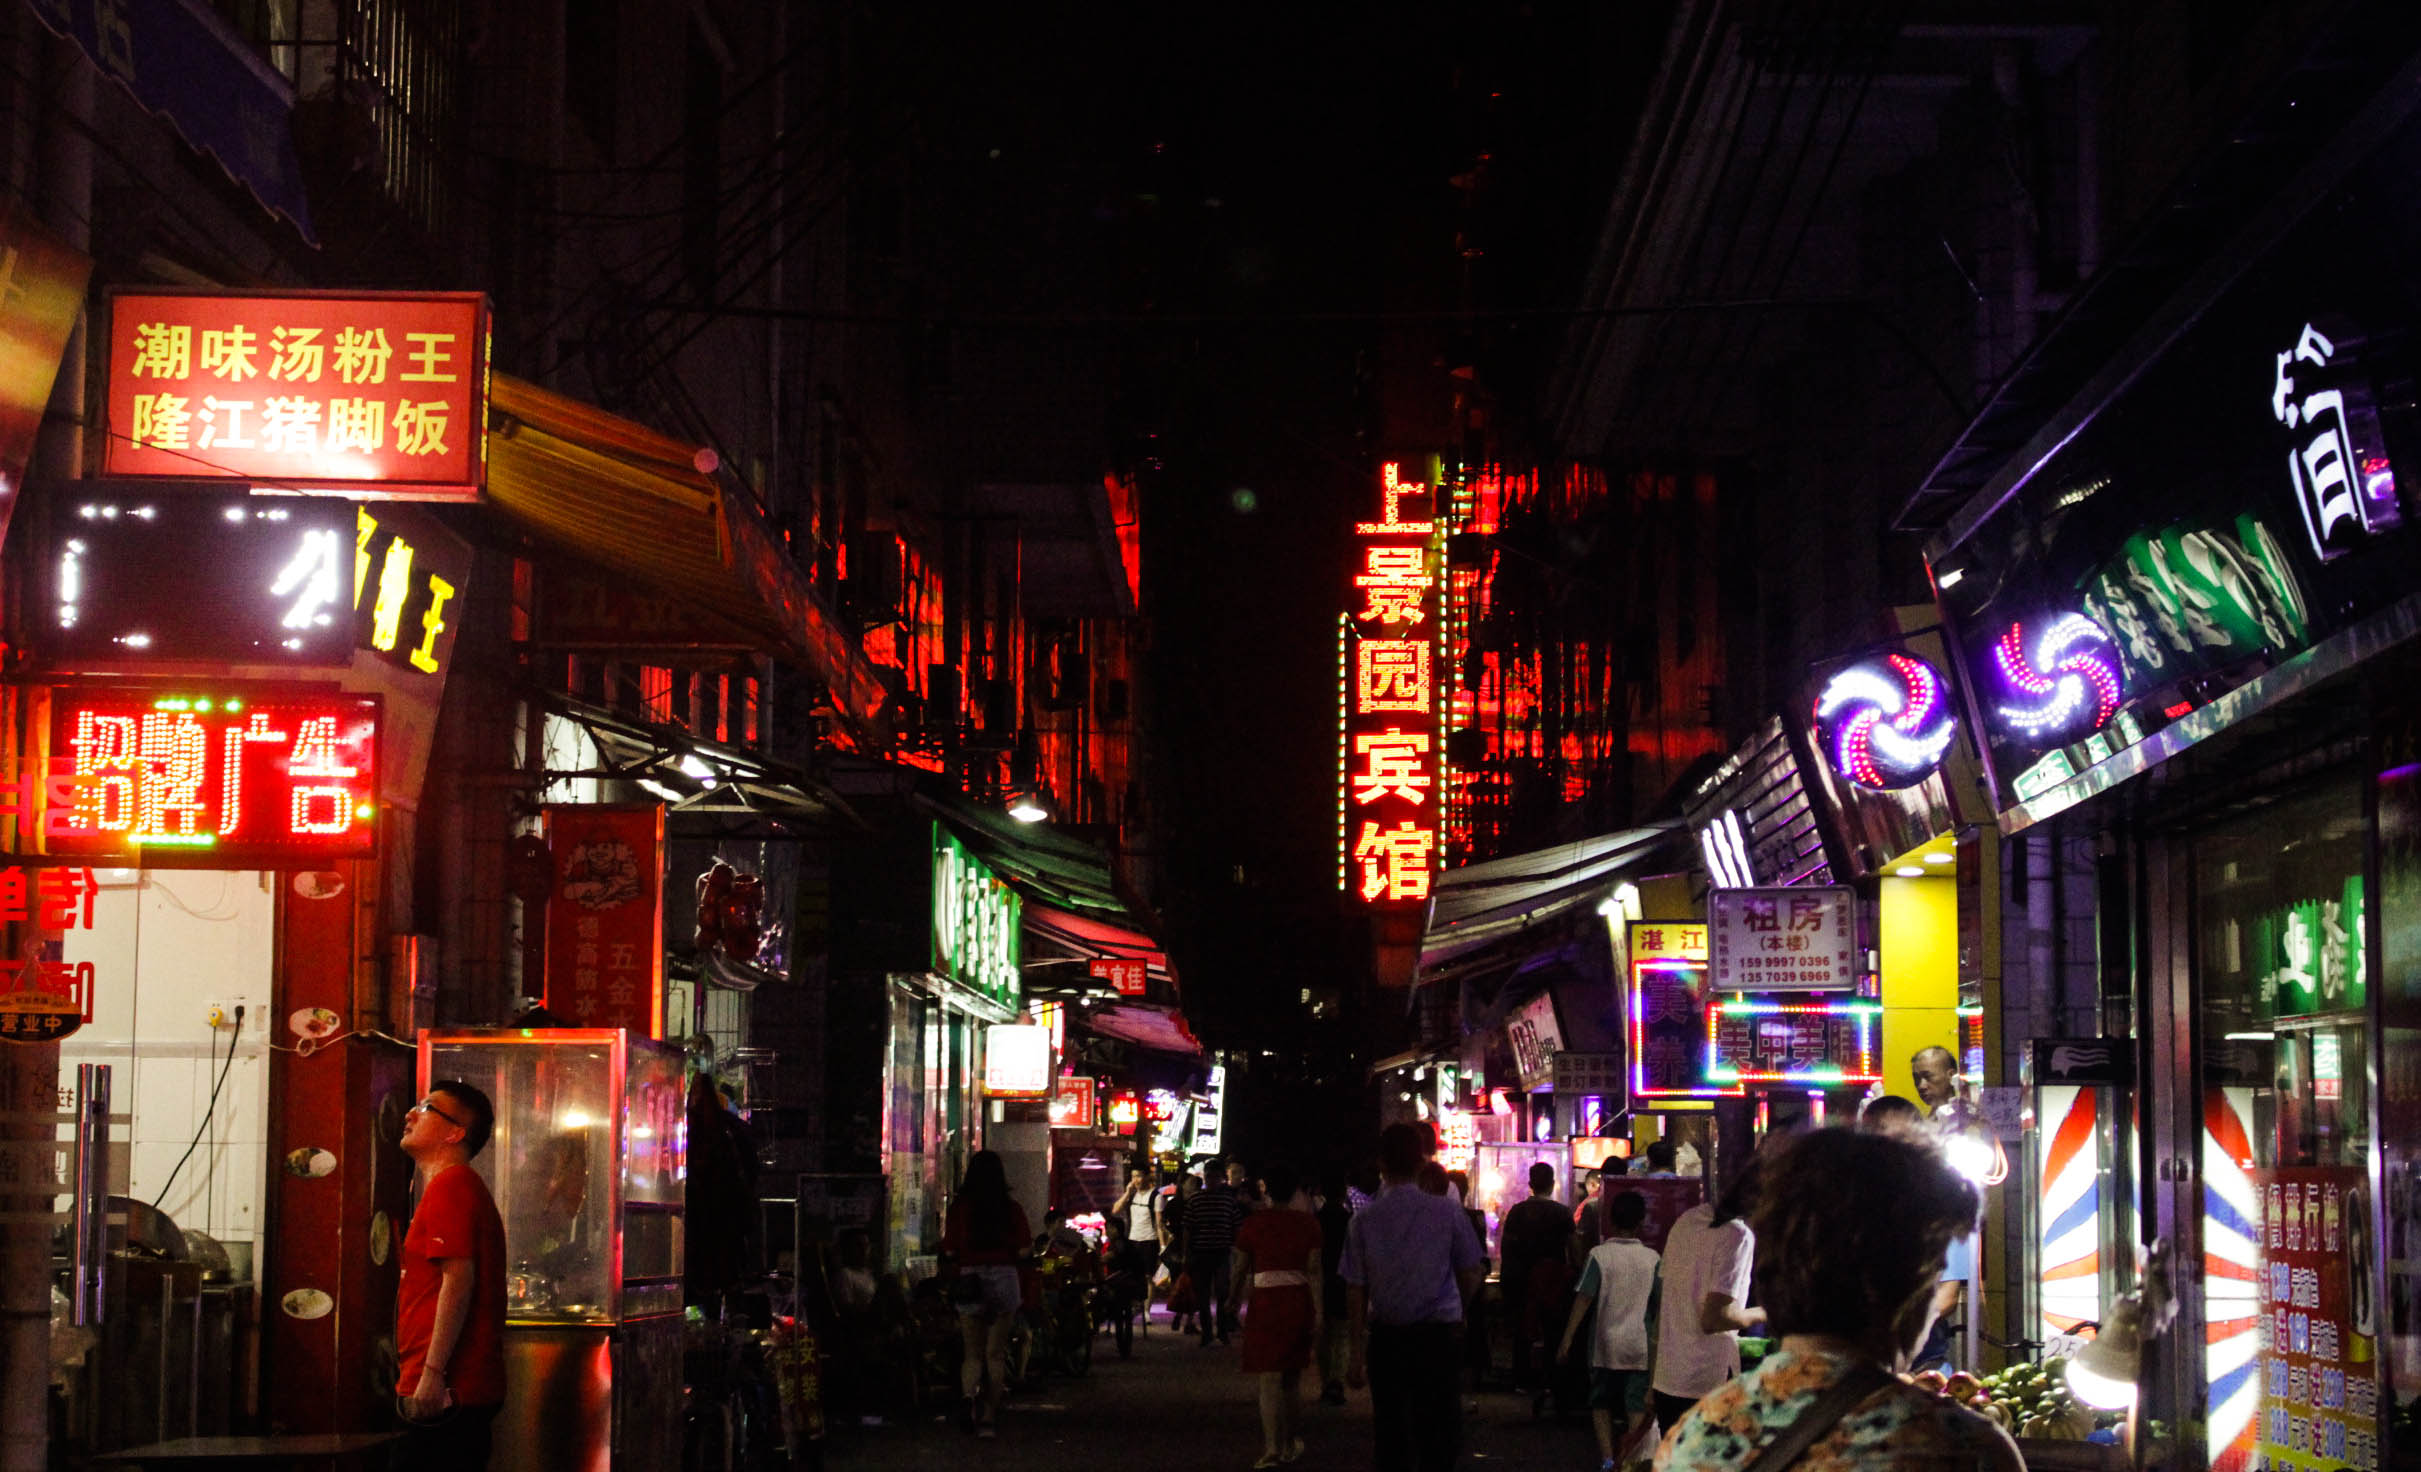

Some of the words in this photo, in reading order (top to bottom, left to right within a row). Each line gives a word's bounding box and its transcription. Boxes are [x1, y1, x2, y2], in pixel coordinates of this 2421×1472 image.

[131, 322, 457, 384] 潮味汤粉王
[131, 395, 450, 457] 隆江猪脚饭
[1353, 462, 1434, 903] 上景园宾馆
[1743, 894, 1824, 933] 租房
[1640, 929, 1704, 951] 湛江
[1759, 935, 1810, 951] (本楼)
[1740, 957, 1761, 968] 159
[1765, 957, 1795, 968] 9997
[1800, 956, 1830, 967] 0396
[1740, 972, 1762, 983] 135
[1766, 972, 1796, 983] 7039
[1800, 971, 1830, 982] 6969
[1, 1014, 62, 1033] 营业中
